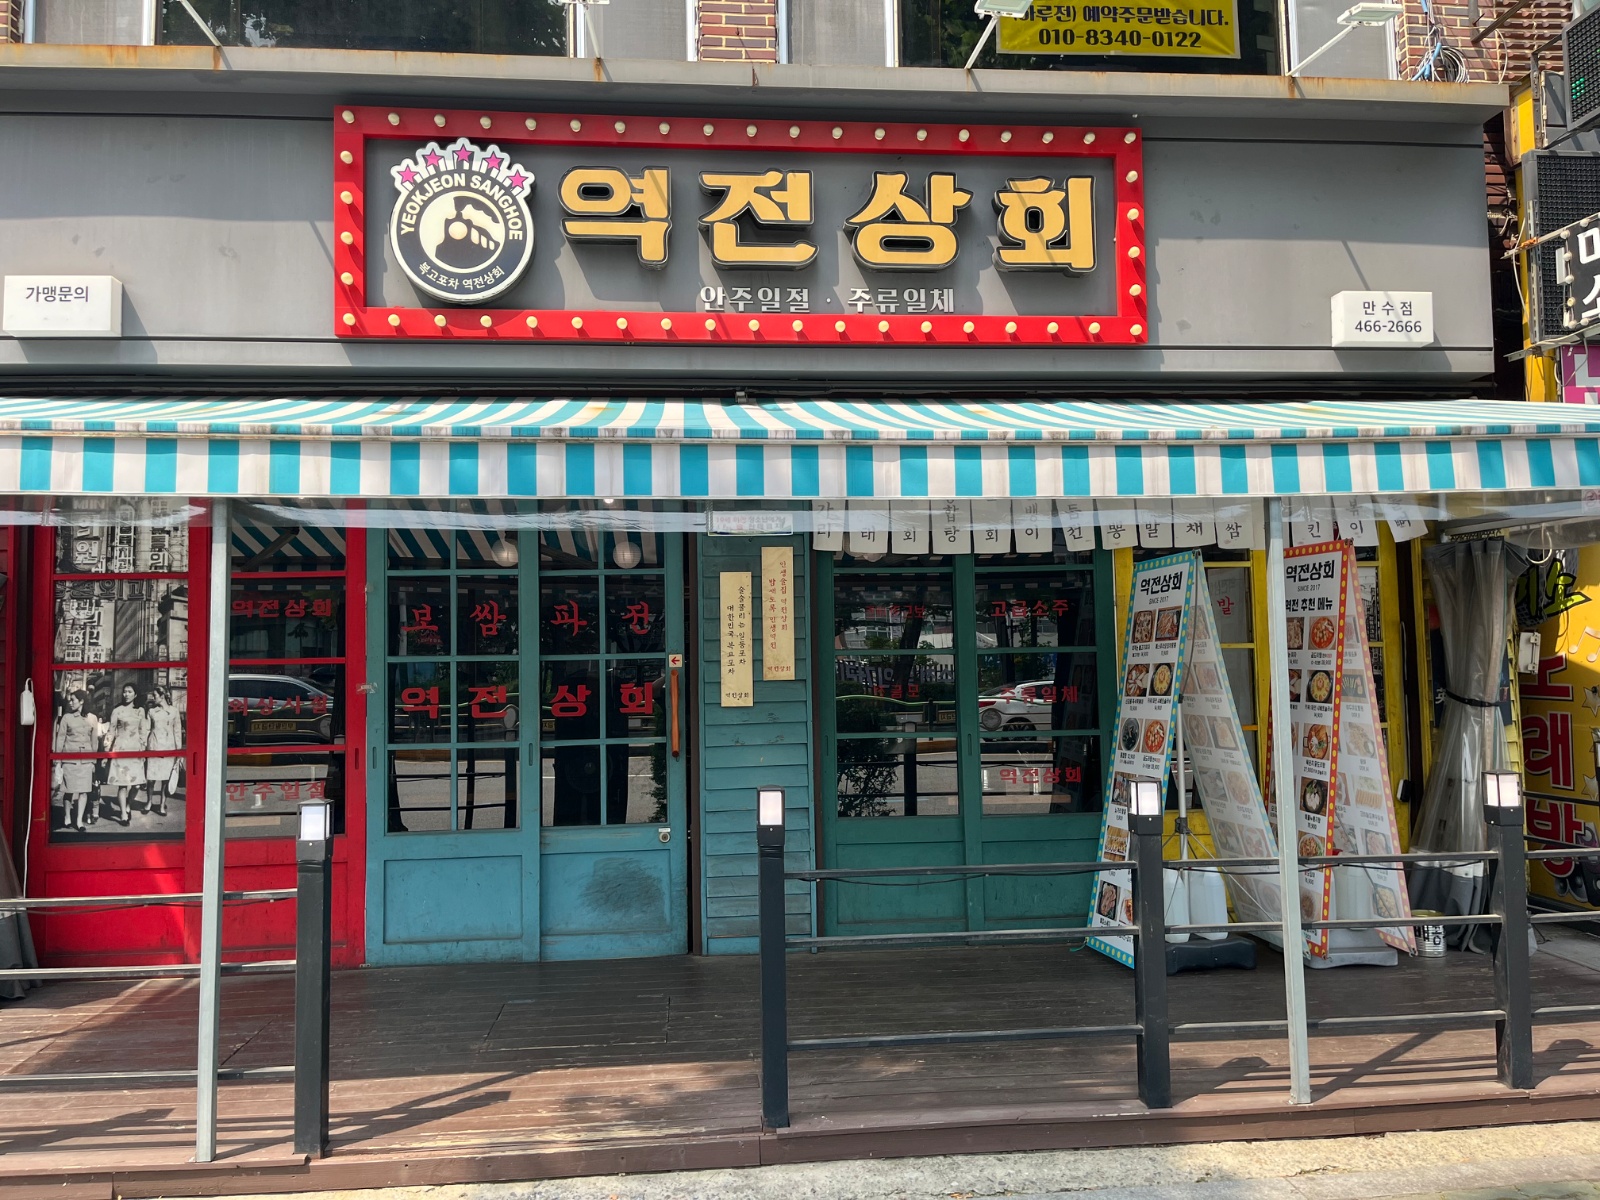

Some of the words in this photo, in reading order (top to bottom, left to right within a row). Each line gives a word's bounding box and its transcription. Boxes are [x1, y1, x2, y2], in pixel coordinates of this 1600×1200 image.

[1083, 5, 1229, 26] 예약주문받습니다.
[1038, 29, 1202, 48] 010-8340-0122
[400, 173, 466, 236] YEOKJEON
[470, 174, 523, 241] SANGHOE
[558, 167, 1096, 270] 역전상회
[418, 261, 460, 290] 복고포차
[462, 265, 505, 291] 역전상회
[25, 285, 89, 303] 가맹문의
[700, 286, 810, 313] 안주일절
[847, 288, 955, 313] 주류일체
[1354, 320, 1422, 333] 466-2666
[1285, 560, 1335, 583] 역전상회
[1140, 571, 1183, 595] 역전상회
[231, 598, 333, 618] 역전상회
[990, 599, 1070, 618] 고급소주
[1286, 599, 1299, 612] 역전
[1301, 597, 1316, 612] 추천
[1317, 596, 1333, 611] 메뉴
[401, 682, 654, 719] 역전상회
[1000, 685, 1079, 704] 주류일체
[1000, 766, 1082, 785] 역전상회
[225, 780, 326, 802] 안주일절
